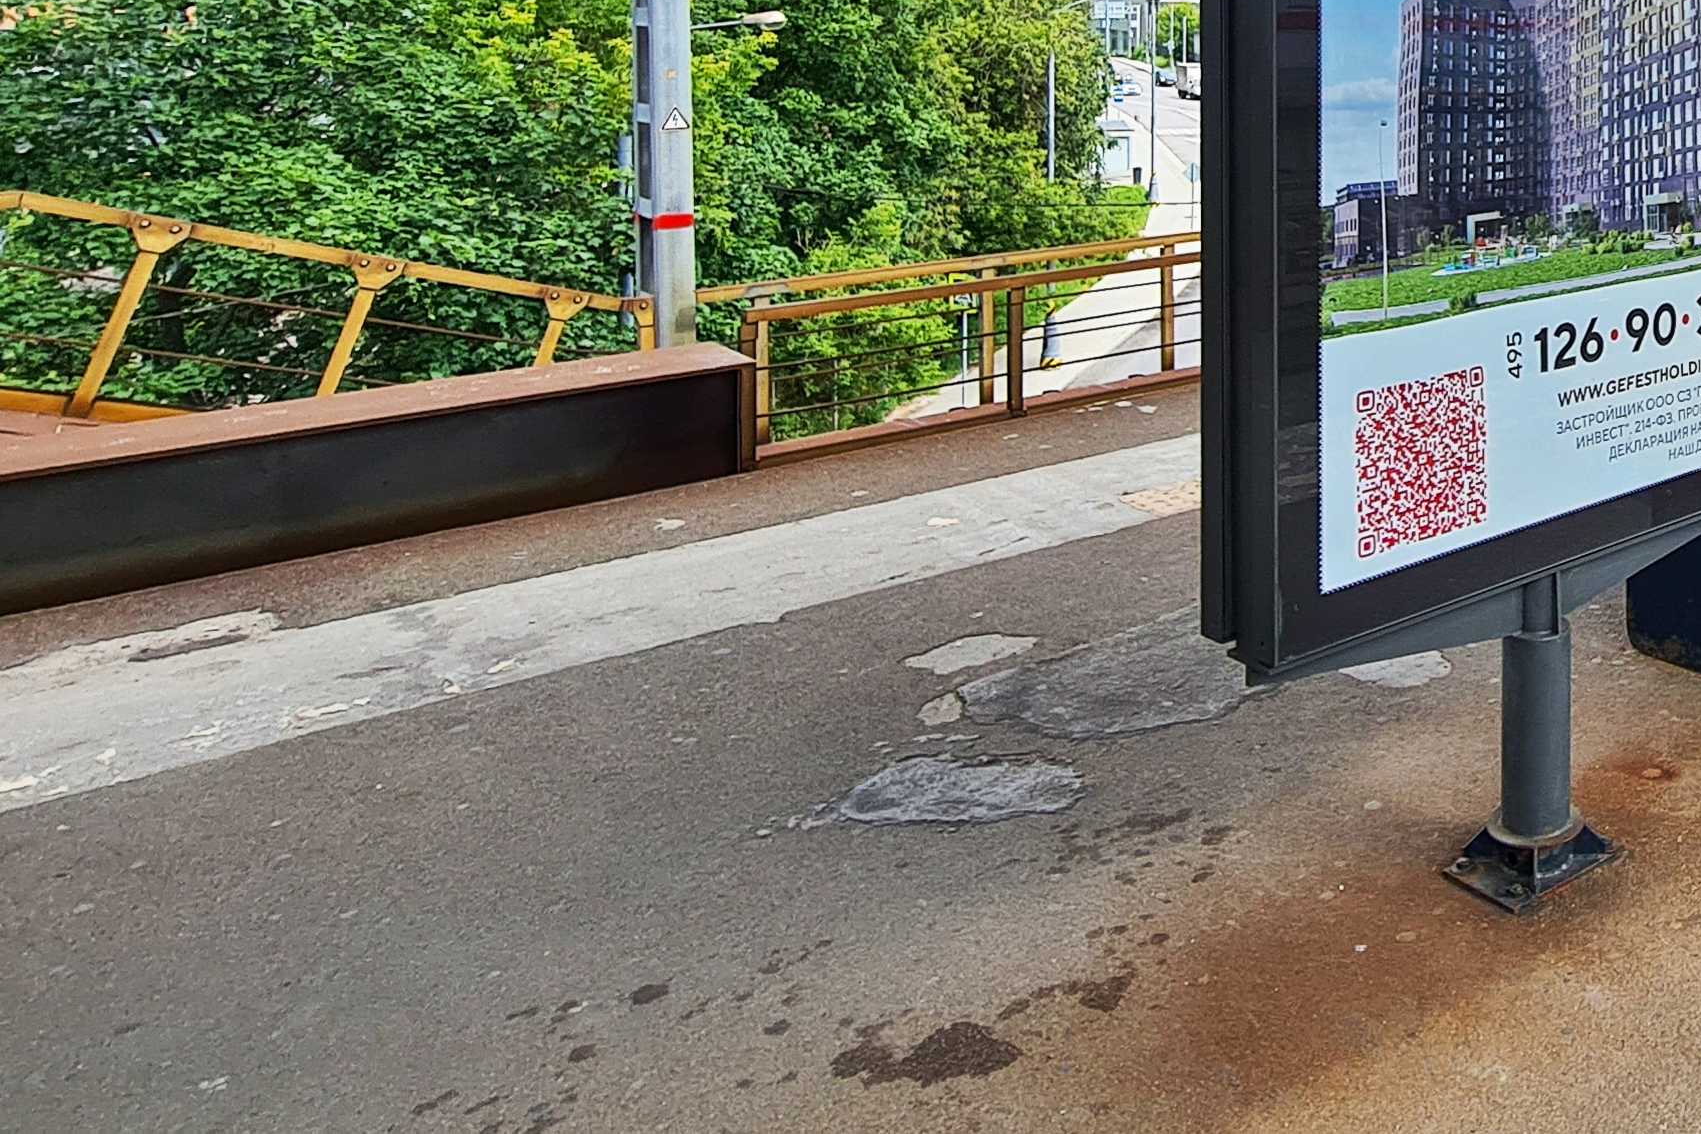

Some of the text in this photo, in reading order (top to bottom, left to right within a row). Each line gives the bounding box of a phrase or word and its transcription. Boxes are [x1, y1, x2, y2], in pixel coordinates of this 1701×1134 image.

[1506, 331, 1523, 379] 495
[1555, 399, 1645, 435] ЗАСТРОЙЩИК
[1608, 426, 1689, 463] ДЕКЛАРАЦИЯ
